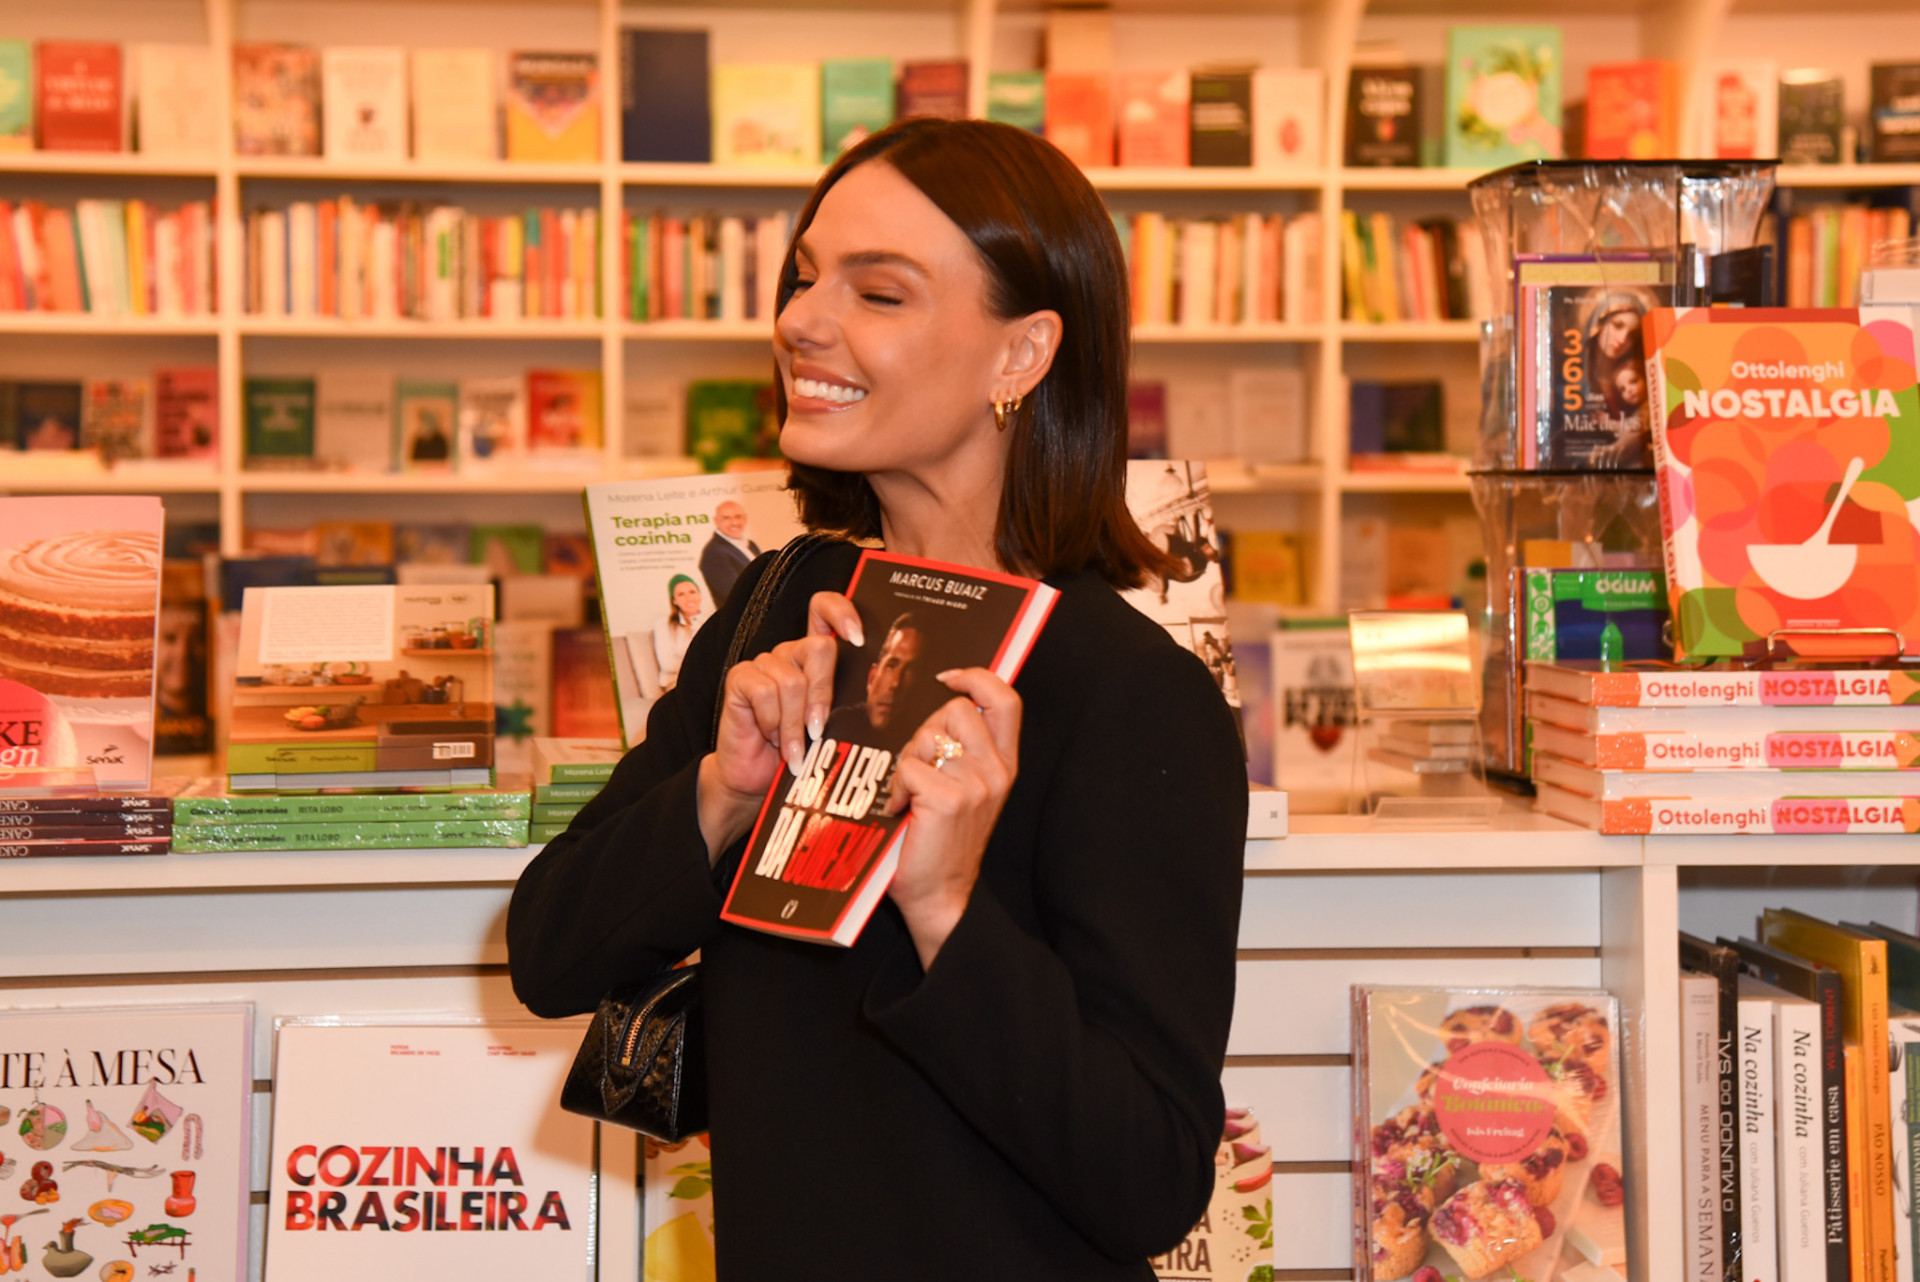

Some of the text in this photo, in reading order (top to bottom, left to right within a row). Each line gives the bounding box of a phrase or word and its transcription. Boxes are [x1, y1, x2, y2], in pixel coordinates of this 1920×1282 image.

[1732, 361, 1845, 383] Ottolenghi
[1683, 388, 1901, 418] NOSTALGIA
[1564, 414, 1596, 432] Mãe
[610, 513, 710, 530] Terapia na
[1658, 470, 1678, 590] NOSTALGIA
[614, 531, 692, 547] cozinha
[888, 570, 989, 601] MARCUS BUAIZ
[1646, 679, 1892, 701] Ottolenghi NOSTALGIA
[1652, 740, 1898, 762] Ottolenghi NOSTALGIA
[785, 737, 837, 808] AS
[812, 741, 853, 810] 7
[825, 744, 892, 820] LEIS
[298, 806, 318, 814] RITA
[320, 805, 343, 813] LOBO
[1658, 807, 1905, 828] Ottolenghi NOSTALGIA
[755, 806, 806, 880] DA
[1718, 1030, 1732, 1075] SAL
[1744, 1026, 1762, 1053] Na
[1793, 1029, 1811, 1058] Na
[53, 1048, 80, 1087] À
[88, 1048, 206, 1087] MESA
[1453, 1077, 1535, 1095] Confeitaria
[1720, 1080, 1732, 1106] DO
[1745, 1058, 1764, 1134] cozinha
[1794, 1062, 1814, 1138] cozinha
[286, 1144, 525, 1187] COZINHA
[1720, 1111, 1734, 1196] MUNDO
[1749, 1142, 1758, 1164] com
[1798, 1146, 1807, 1169] com
[1826, 1085, 1844, 1245] Pâtisserie em casa
[1873, 1123, 1885, 1196] PÃO NOSSO
[1698, 1104, 1716, 1282] MENU PARA A SEMAN
[285, 1190, 572, 1232] BRASILEIRA
